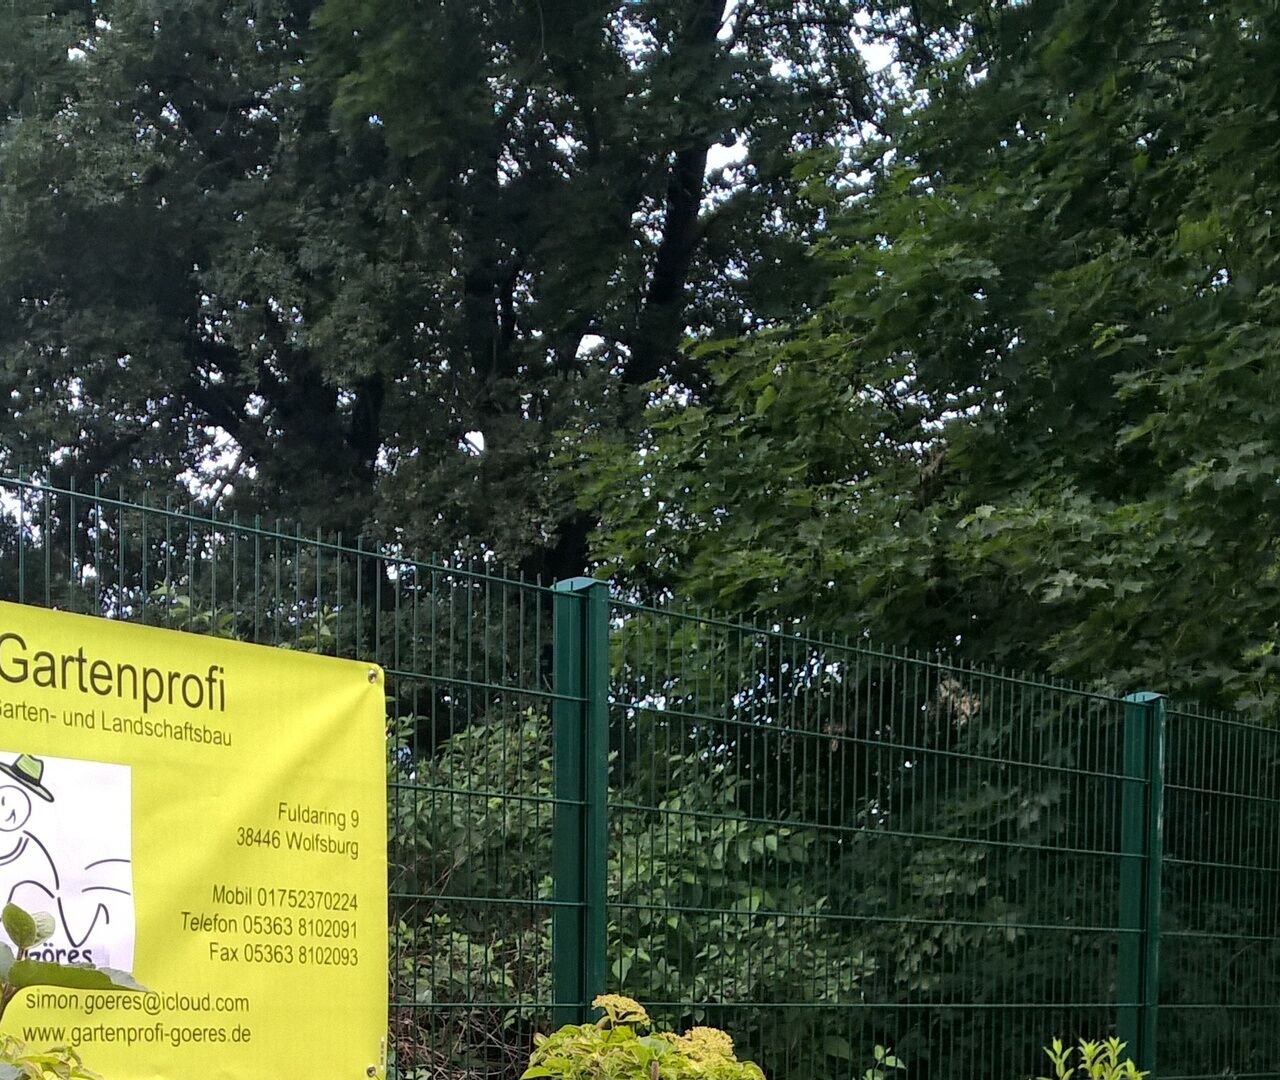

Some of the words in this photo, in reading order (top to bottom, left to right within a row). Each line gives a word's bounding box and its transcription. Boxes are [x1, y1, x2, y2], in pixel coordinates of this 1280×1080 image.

[63, 708, 95, 729] und
[101, 711, 232, 747] Landschaftsbau
[278, 802, 346, 831] Fuldaring
[351, 810, 360, 828] 9
[236, 826, 281, 849] 38446
[286, 831, 359, 860] Wolfsburg
[212, 884, 252, 905] Mobil
[257, 887, 358, 911] 01752370224
[181, 911, 238, 933] Telefon
[243, 915, 293, 936] 05363
[298, 917, 357, 938] 8102091
[209, 941, 239, 962] Fax
[244, 943, 294, 964] 05363
[298, 945, 359, 966] 8102093
[25, 989, 250, 1016] simon.goeres@icloud.com
[23, 1022, 251, 1048] www.gartenprofi-goeres.de
